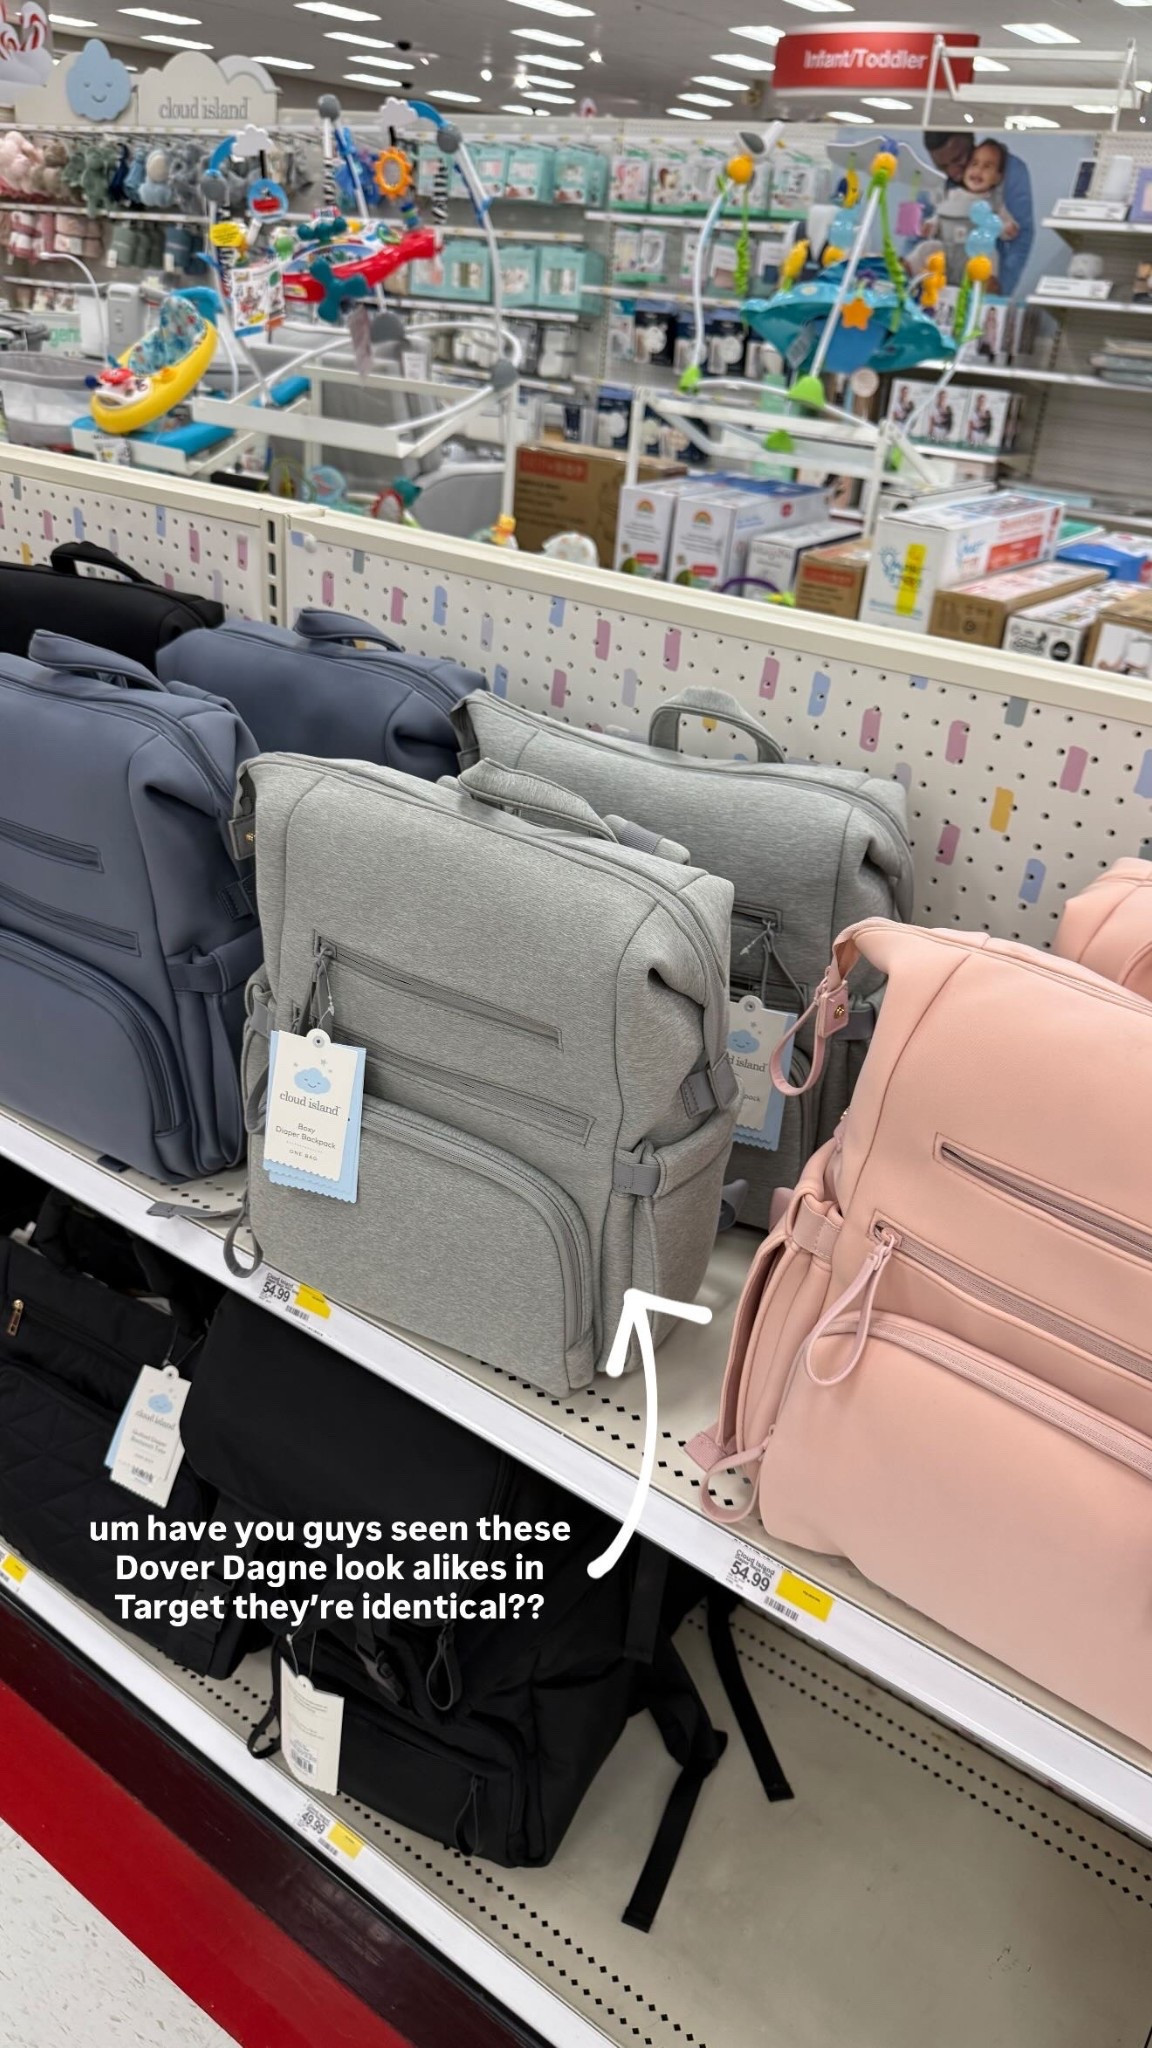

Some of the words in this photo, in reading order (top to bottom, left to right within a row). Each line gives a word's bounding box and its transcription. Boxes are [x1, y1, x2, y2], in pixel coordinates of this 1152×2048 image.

[803, 48, 928, 70] Infant/Toddler
[159, 96, 199, 119] cloud
[201, 96, 249, 120] island
[736, 1057, 766, 1072] island
[279, 1091, 306, 1107] cloud
[308, 1098, 340, 1117] island
[275, 1125, 300, 1139] Diaper
[301, 1133, 336, 1150] Backpack
[298, 1122, 316, 1135] Boxy
[263, 1282, 291, 1303] 54.99
[730, 1560, 770, 1592] 54.99
[301, 1812, 326, 1835] 49.99
